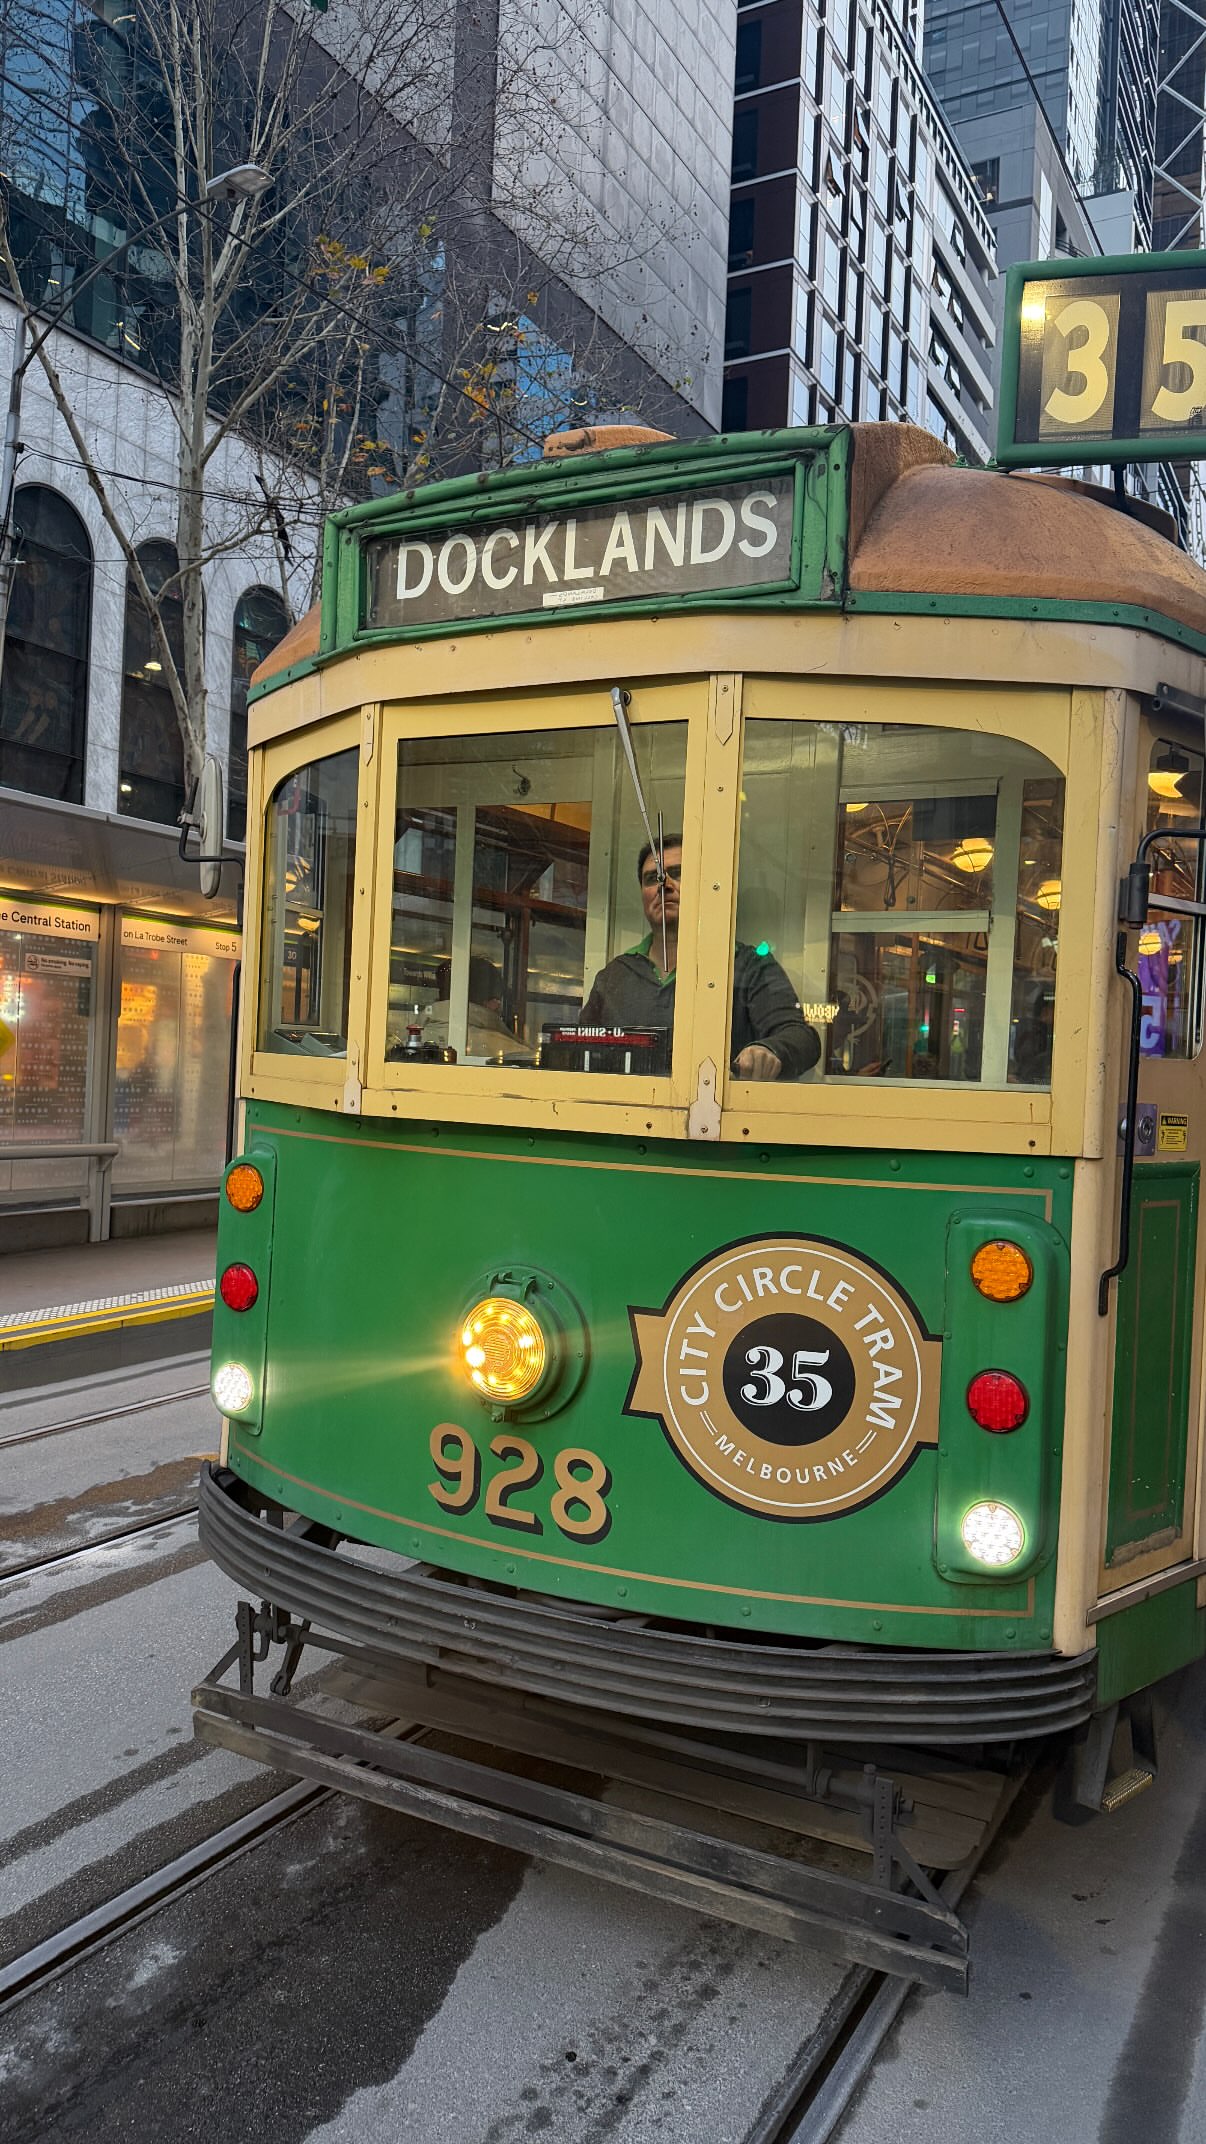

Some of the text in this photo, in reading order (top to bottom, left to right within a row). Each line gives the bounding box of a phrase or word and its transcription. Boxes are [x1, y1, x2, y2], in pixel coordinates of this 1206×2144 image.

[396, 490, 778, 600] DOCKLANDS
[11, 911, 51, 927] Central
[54, 917, 91, 932] Station
[123, 930, 188, 946] on La Trobe Street
[215, 941, 237, 952] Stop 5
[679, 1264, 904, 1430] CITY CIRCLE TRAM
[740, 1345, 833, 1411] 35
[427, 1422, 613, 1545] 928
[714, 1434, 858, 1484] MELBOURNE
